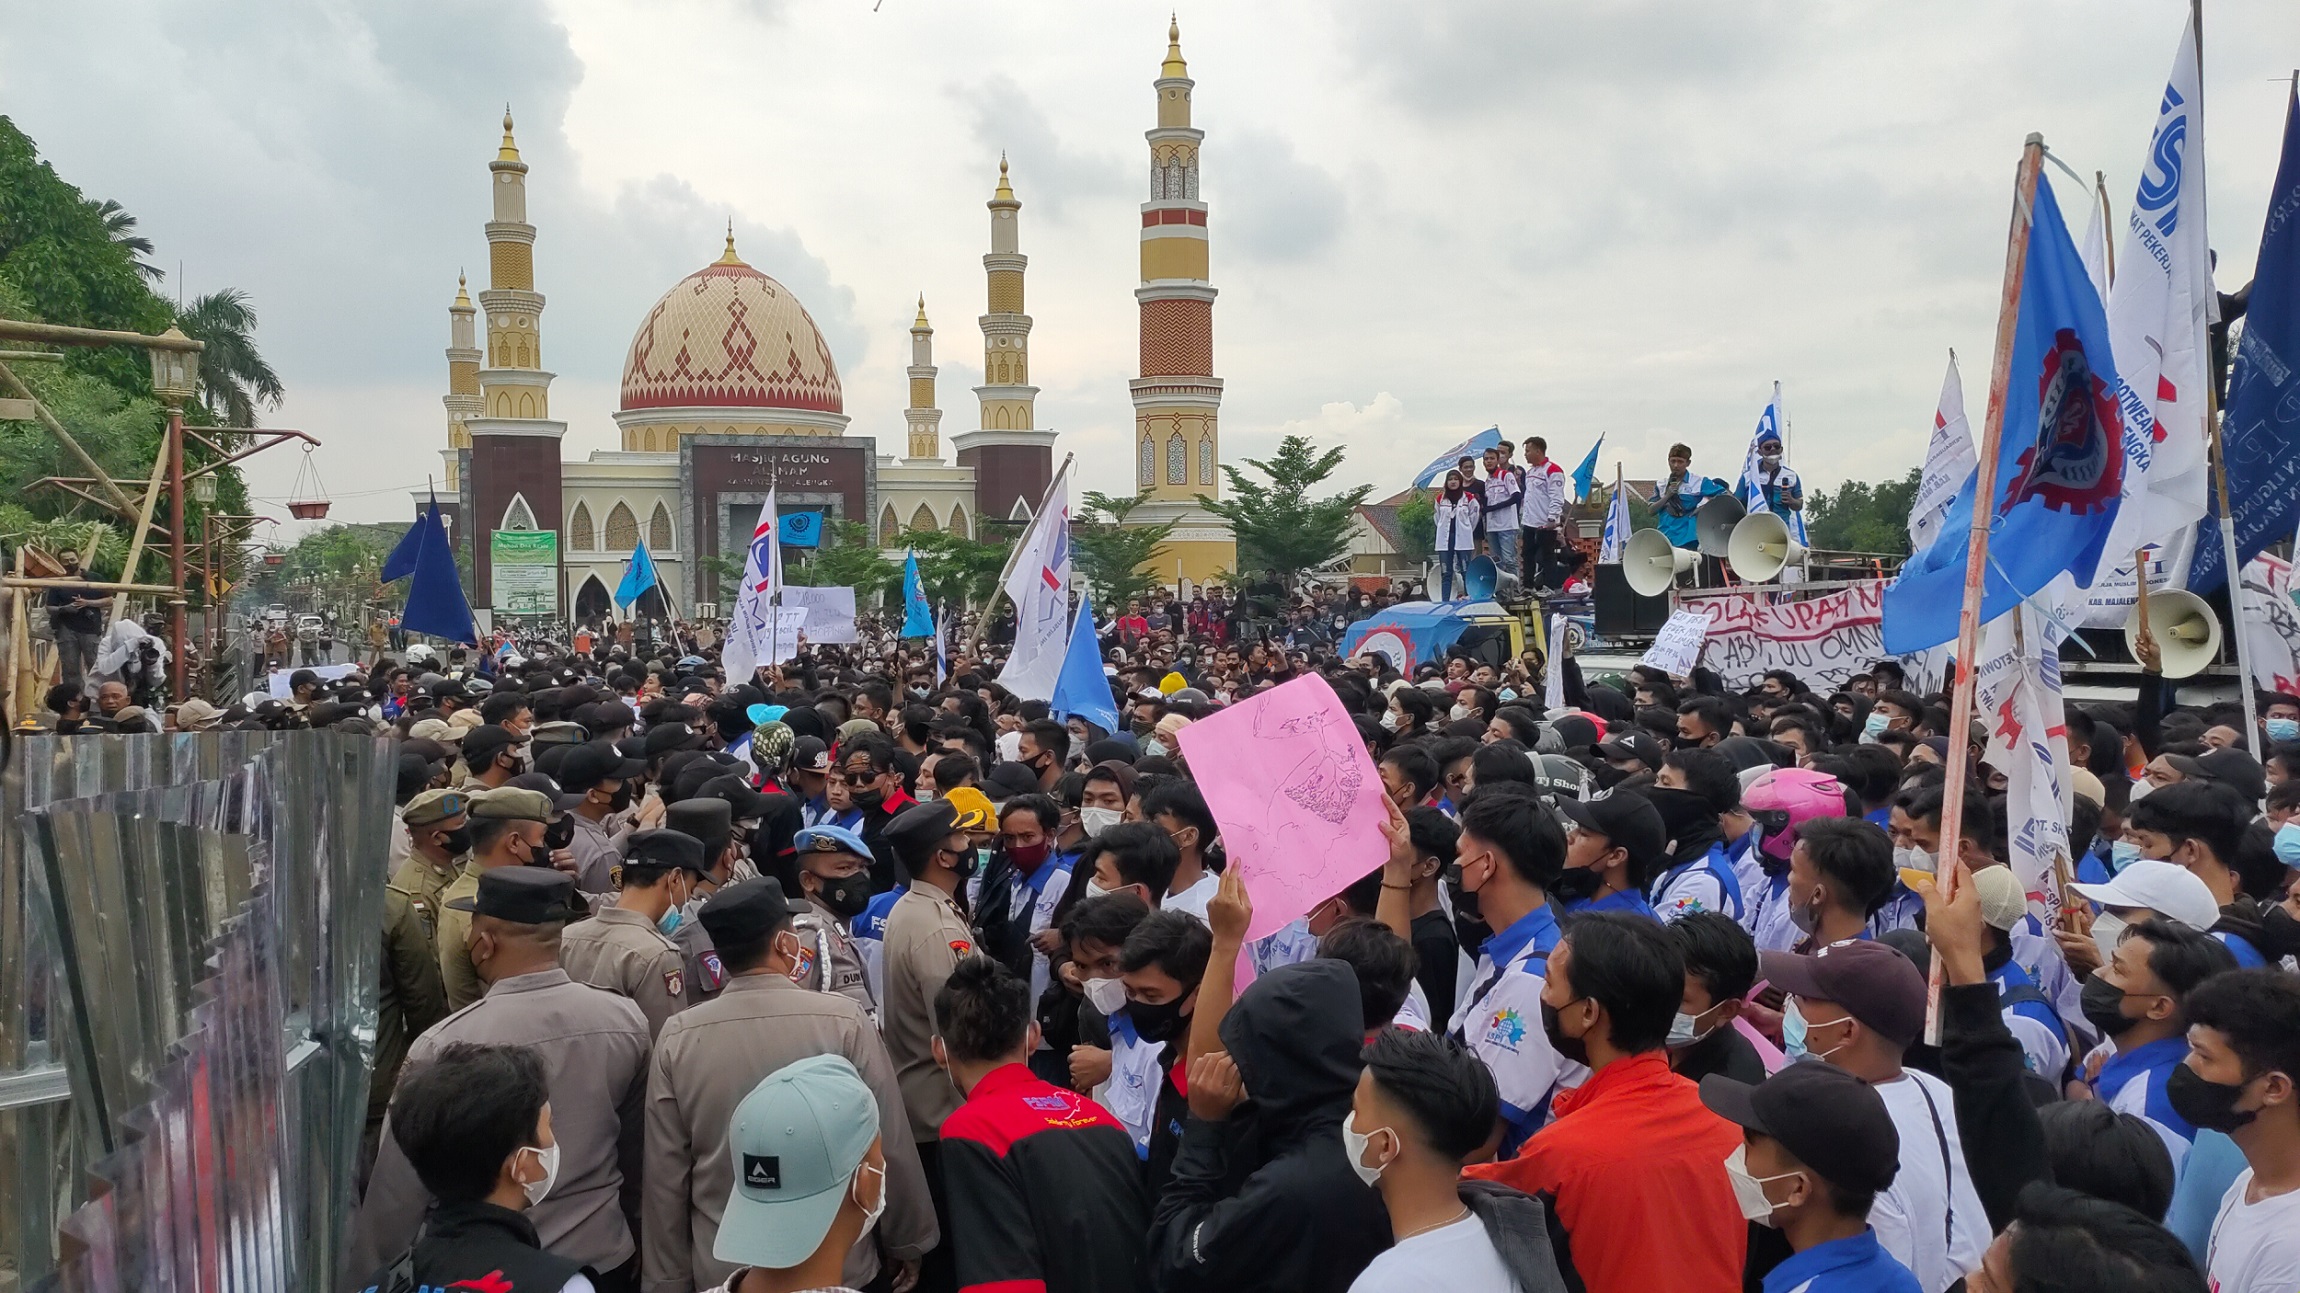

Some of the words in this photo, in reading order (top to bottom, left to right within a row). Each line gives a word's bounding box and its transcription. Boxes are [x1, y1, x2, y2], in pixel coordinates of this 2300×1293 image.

[730, 453, 777, 464] MASJID
[782, 453, 830, 464] AGUNG
[1772, 600, 1850, 631] UPAH
